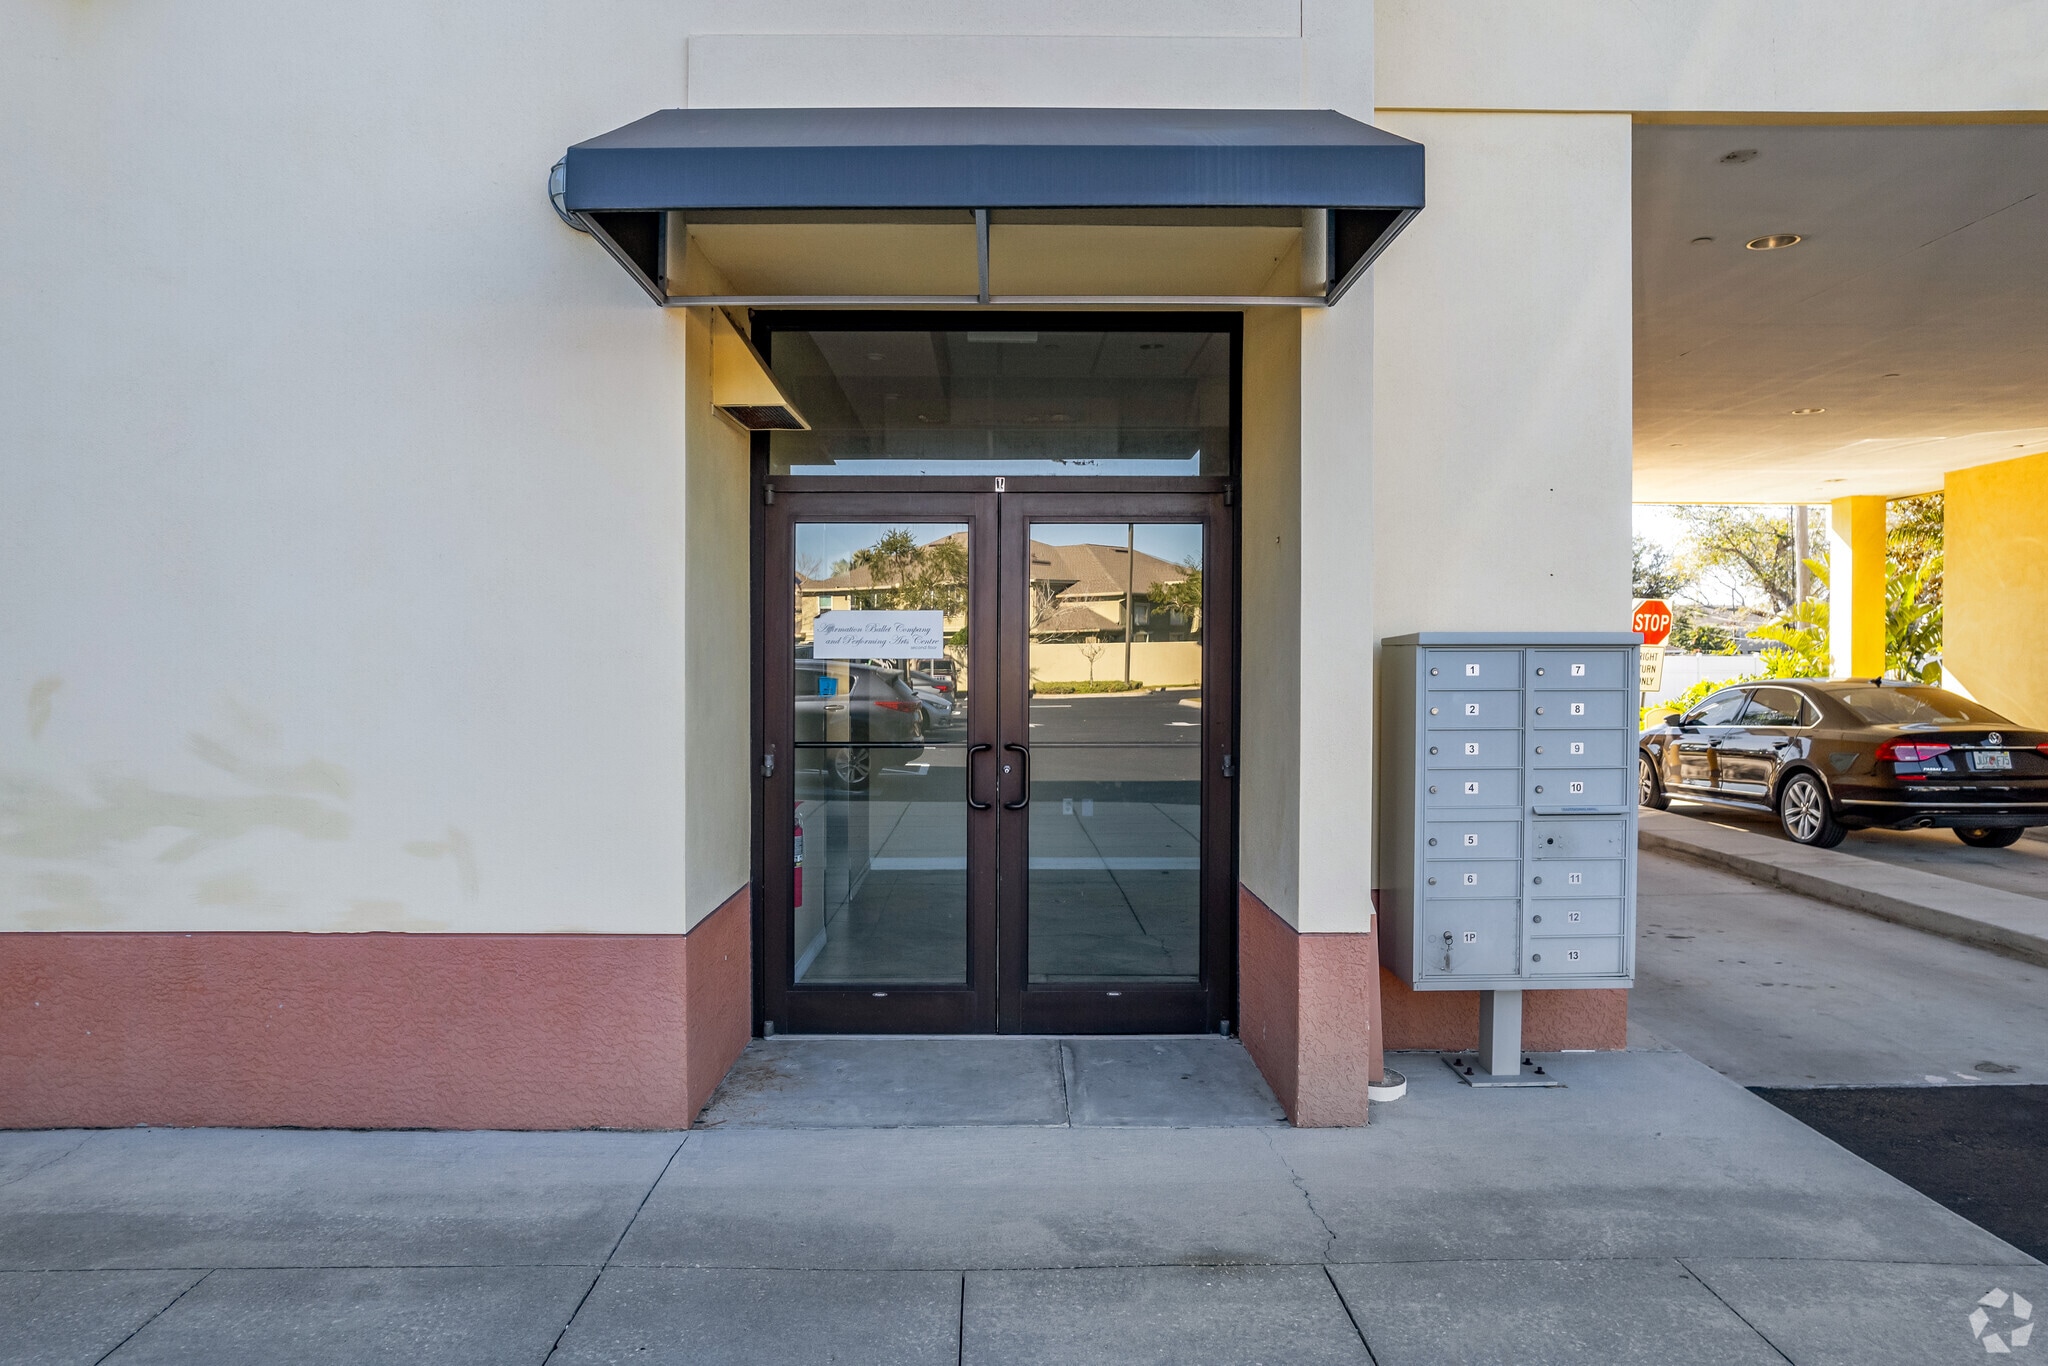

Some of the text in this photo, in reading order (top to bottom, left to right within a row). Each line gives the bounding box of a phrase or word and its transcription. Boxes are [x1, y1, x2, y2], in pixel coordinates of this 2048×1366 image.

[1634, 613, 1670, 631] STOP
[817, 622, 931, 636] Affirmation Ballet Company
[825, 634, 940, 647] and Performing Arts Centre
[1470, 666, 1475, 674] 1
[1576, 666, 1581, 674] 7
[1640, 664, 1656, 673] URN
[1640, 676, 1655, 686] NLY
[1469, 705, 1476, 714] 2
[1574, 705, 1581, 714] 8
[1469, 745, 1475, 753] 3
[1574, 744, 1580, 753] 9
[1468, 784, 1475, 792] 4
[1571, 783, 1582, 792] 10
[1468, 836, 1474, 845] 5
[1467, 875, 1473, 884] 6
[1570, 874, 1580, 883] 11
[1569, 913, 1580, 922] 12
[1465, 933, 1476, 942] 1P
[1568, 951, 1579, 960] 13
